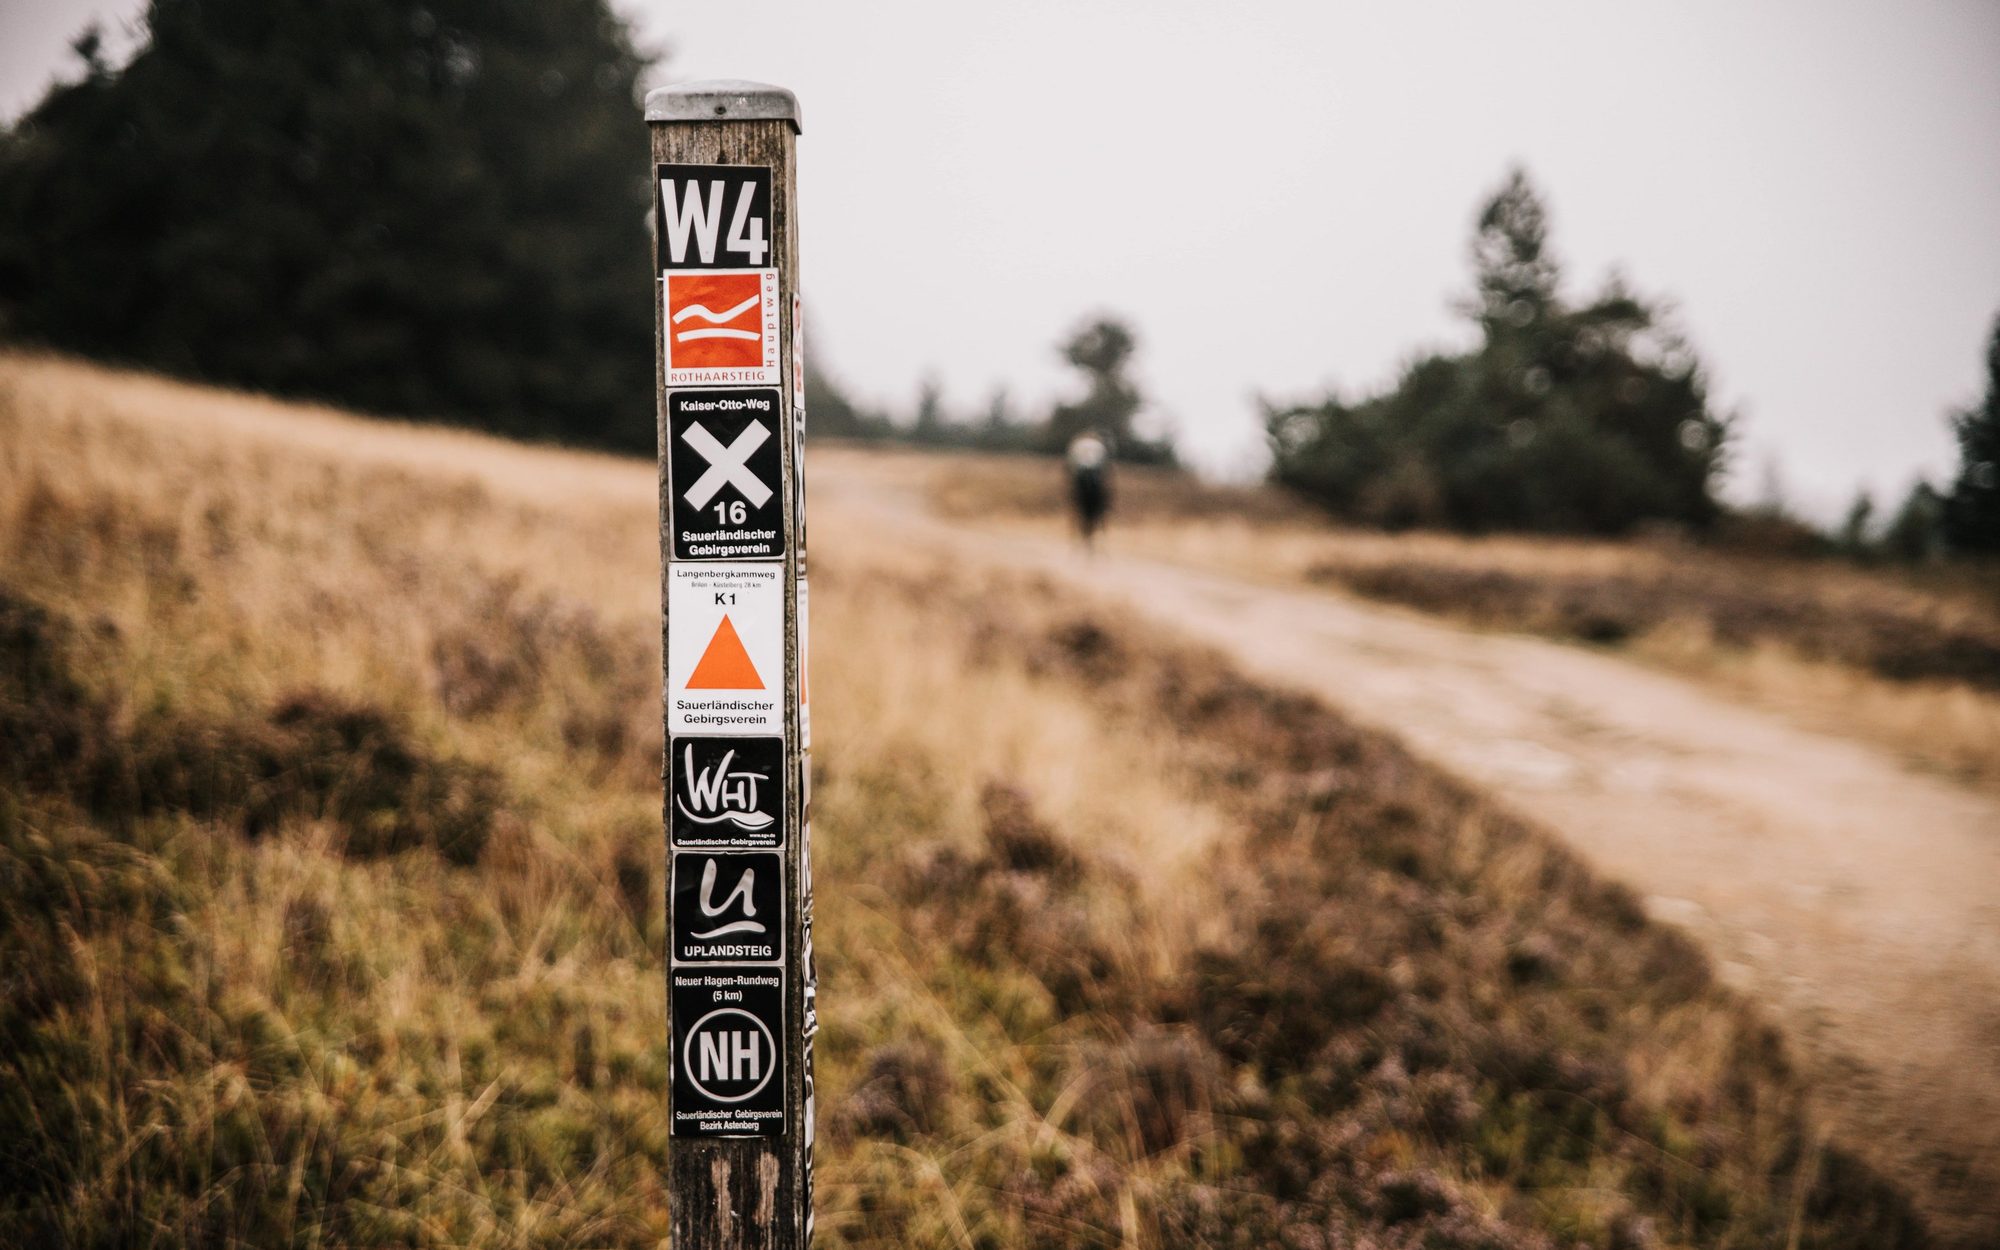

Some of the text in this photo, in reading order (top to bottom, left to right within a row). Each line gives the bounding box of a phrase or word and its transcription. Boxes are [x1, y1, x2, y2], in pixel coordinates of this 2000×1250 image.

[660, 178, 769, 265] W4
[766, 273, 777, 367] Hauptweg
[671, 371, 765, 382] ROTHAARSTEIG
[680, 398, 770, 411] Kaiser-Otto-Weg
[713, 501, 747, 525] 16
[682, 529, 776, 541] Sauerländischer
[689, 543, 770, 556] Gebirgsverein
[677, 570, 775, 579] Langenbergkammweg
[676, 700, 774, 710] Sauerländischer
[683, 714, 767, 725] Gebirgsverein
[684, 945, 772, 956] UPLANDSTEIG
[675, 975, 779, 987] Neuer Hagen-Rundweg
[713, 990, 743, 1002] (5 km)
[700, 1031, 759, 1081] NH
[676, 1109, 782, 1120] Sauerländischer Gebirgsverein
[700, 1121, 759, 1131] Bezirk Astenberg
